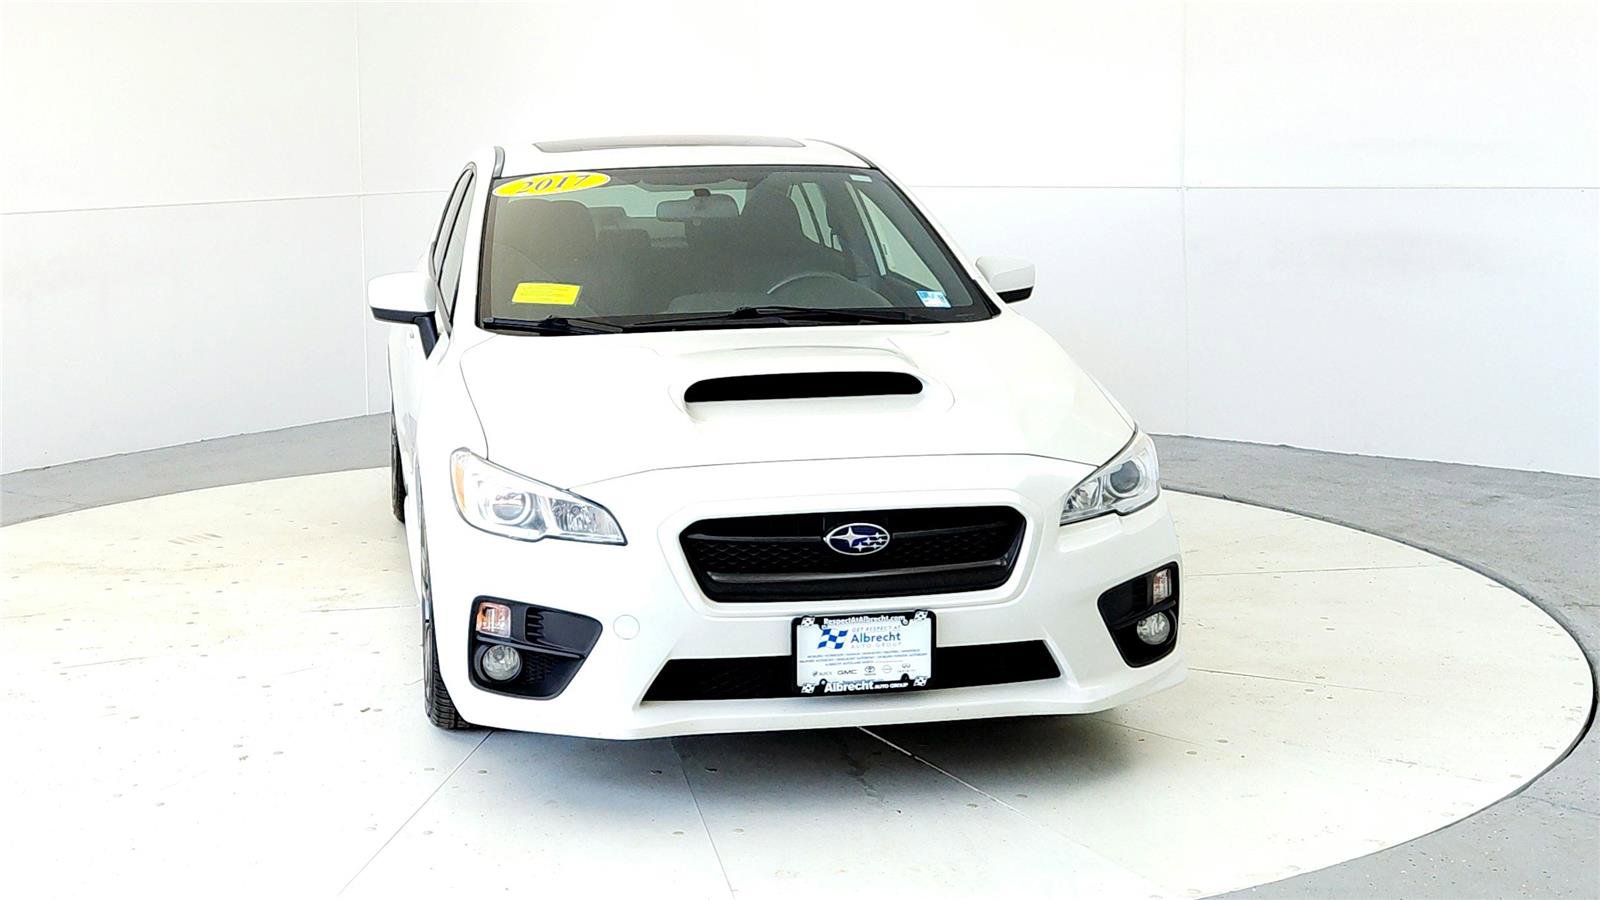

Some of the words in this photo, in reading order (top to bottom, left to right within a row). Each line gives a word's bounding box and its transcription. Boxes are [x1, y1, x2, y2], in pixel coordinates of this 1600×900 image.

[515, 174, 591, 194] 2017
[823, 615, 905, 625] RespectAtAlbrecht.com
[850, 632, 901, 643] Albrecht
[824, 681, 874, 693] Albrecht
